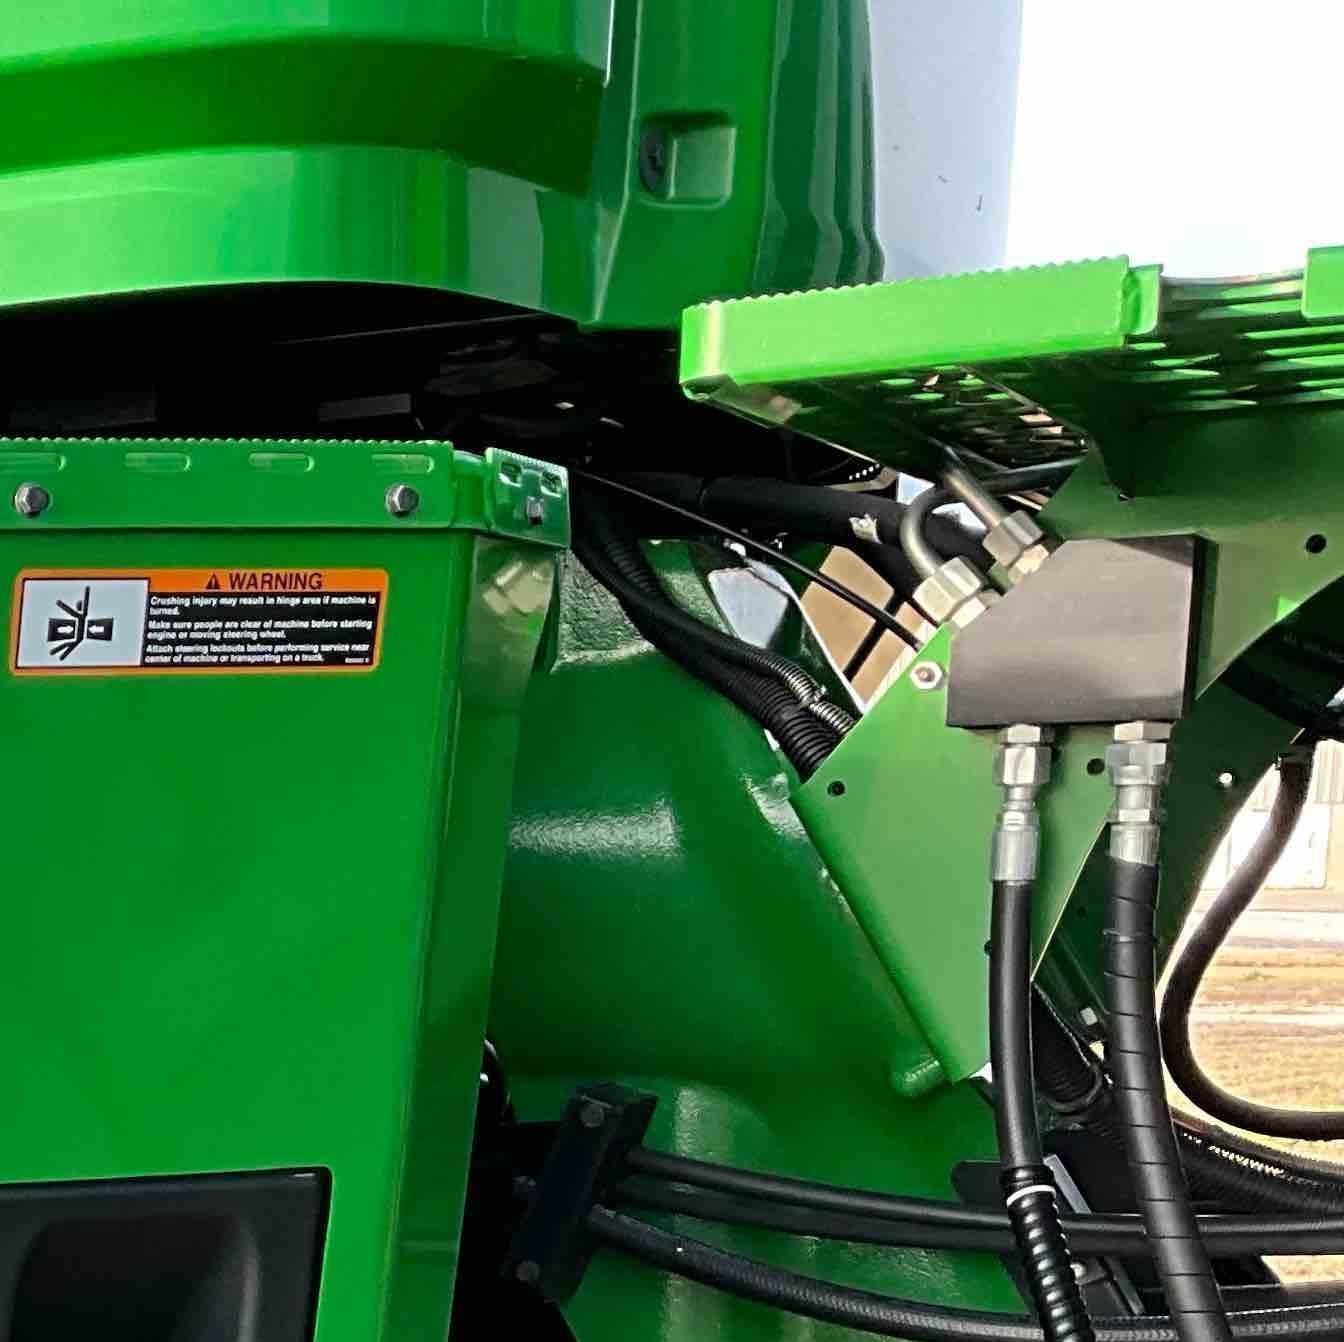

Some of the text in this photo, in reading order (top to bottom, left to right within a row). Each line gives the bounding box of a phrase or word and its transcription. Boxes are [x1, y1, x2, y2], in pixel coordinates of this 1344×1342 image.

[229, 572, 322, 590] WARNING
[150, 595, 190, 607] Crushing
[192, 595, 218, 608] injury
[239, 596, 265, 605] result
[331, 596, 366, 604] machine
[148, 620, 171, 629] Make
[193, 620, 223, 632] people
[240, 620, 262, 629] clear
[263, 619, 272, 628] of
[273, 619, 309, 628] machine
[311, 619, 338, 628] before
[339, 619, 372, 630] starting
[178, 631, 188, 639] or
[223, 630, 258, 641] steering
[146, 643, 173, 653] Attach
[274, 642, 319, 653] performing
[173, 654, 182, 663] of
